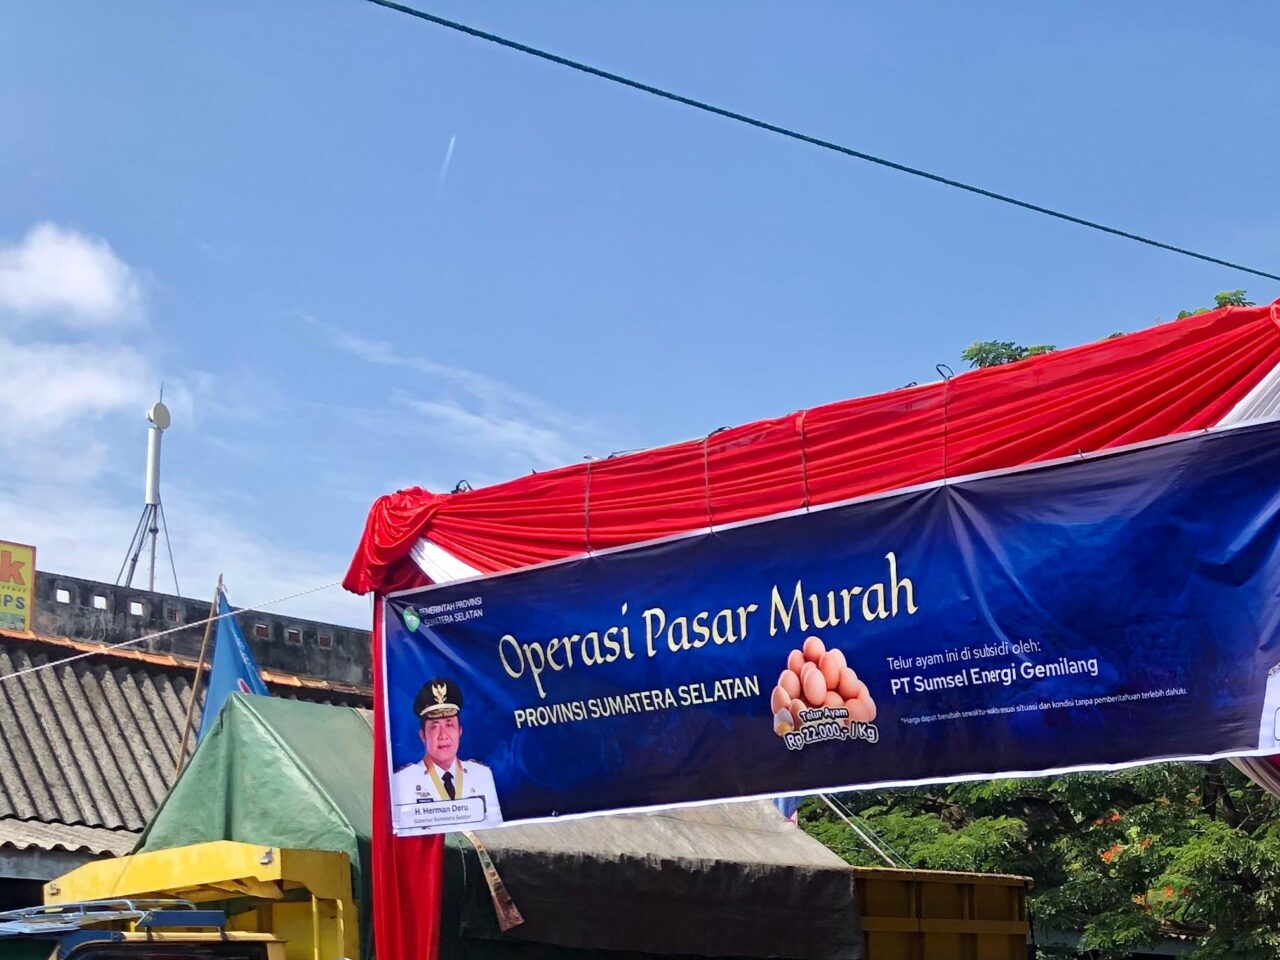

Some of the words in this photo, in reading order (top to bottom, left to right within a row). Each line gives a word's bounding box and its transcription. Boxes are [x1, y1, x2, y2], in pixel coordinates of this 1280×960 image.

[0, 594, 26, 609] PS
[419, 603, 455, 615] PEMERINTAH
[454, 609, 483, 622] SELATAN
[498, 603, 633, 699] Operasi
[641, 604, 760, 658] Pasar
[769, 551, 920, 637] Murah
[887, 656, 913, 671] Telur
[915, 653, 944, 670] ayam
[945, 650, 959, 663] ini
[960, 647, 971, 661] di
[973, 641, 1009, 659] subsidi
[1012, 639, 1041, 655] oleh:
[890, 677, 910, 695] PT
[913, 669, 969, 692] Sumsel
[971, 663, 1017, 686] Energi
[1020, 657, 1099, 679] Gemilang
[514, 701, 590, 729] PROVINSI
[589, 687, 676, 719] SUMATERA
[678, 675, 760, 709] SELATAN
[1039, 701, 1052, 709] dan
[800, 711, 822, 721] Telur
[824, 708, 848, 718] Ayam
[786, 734, 803, 748] Rp
[859, 724, 875, 741] Kg
[423, 806, 450, 815] Herman
[451, 804, 469, 812] Deru
